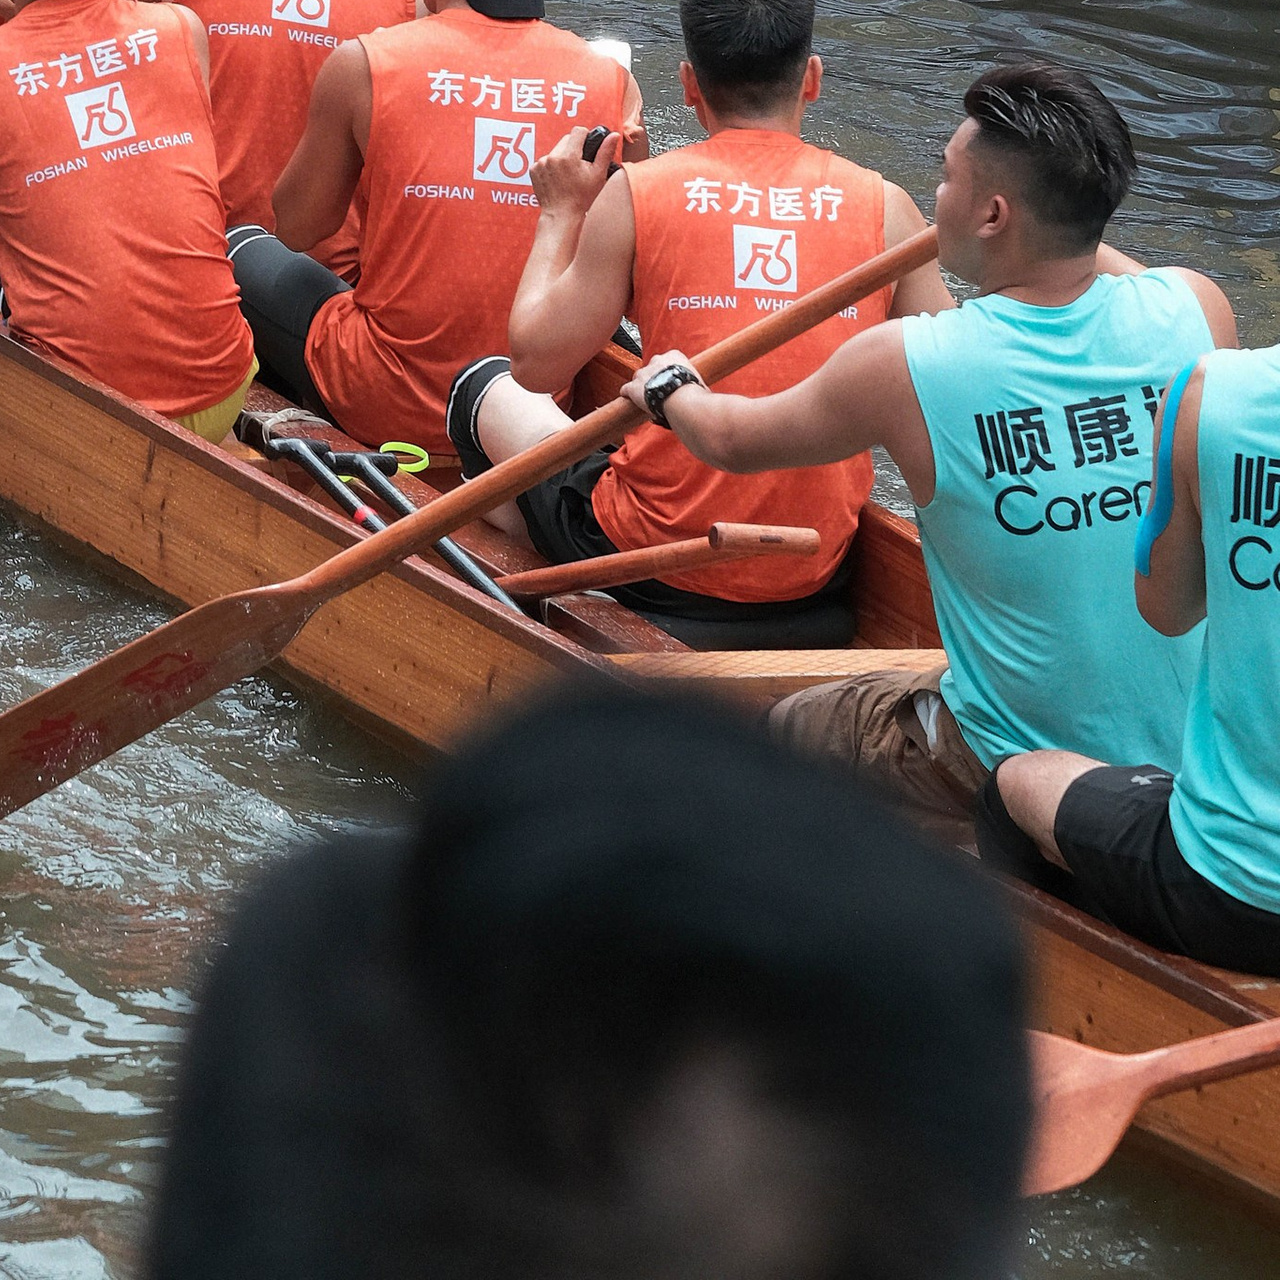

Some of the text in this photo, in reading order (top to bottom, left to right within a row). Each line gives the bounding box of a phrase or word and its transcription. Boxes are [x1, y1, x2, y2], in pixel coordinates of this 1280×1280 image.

[208, 23, 347, 50] FOSHAN WHEEL
[9, 27, 161, 98] 东方医疗
[427, 69, 589, 119] 东方医疗
[25, 130, 195, 187] FOSHAN WHEELCHAIR
[404, 184, 475, 201] FOSHAN
[683, 177, 845, 224] 东方医疗
[669, 294, 738, 311] FOSHAN
